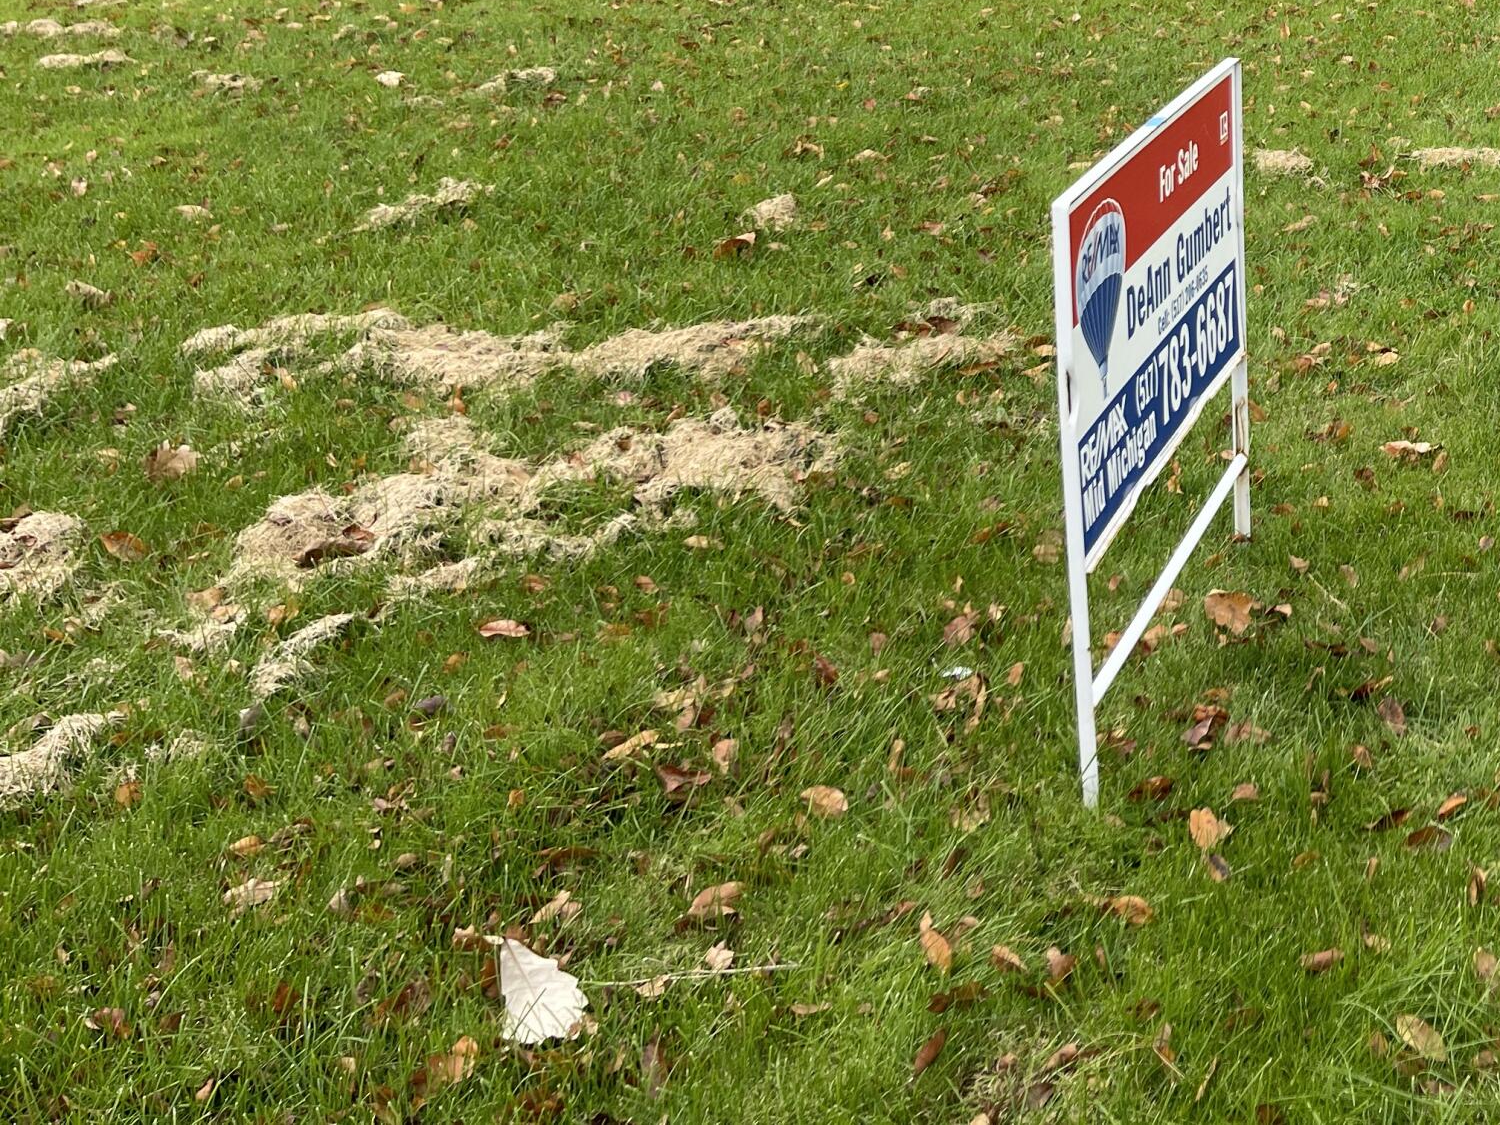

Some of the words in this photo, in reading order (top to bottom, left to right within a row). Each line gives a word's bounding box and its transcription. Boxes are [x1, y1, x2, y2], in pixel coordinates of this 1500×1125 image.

[1159, 162, 1177, 204] For
[1177, 139, 1199, 186] Sale
[1081, 222, 1121, 284] RE/MAX
[1126, 255, 1172, 341] DeAnn
[1176, 185, 1232, 284] Gumbert
[1079, 393, 1129, 489] RE/MAX
[1135, 355, 1160, 418] (517)
[1158, 268, 1234, 426] 783-6687
[1082, 468, 1107, 533] Mid
[1106, 410, 1158, 500] Michigan
